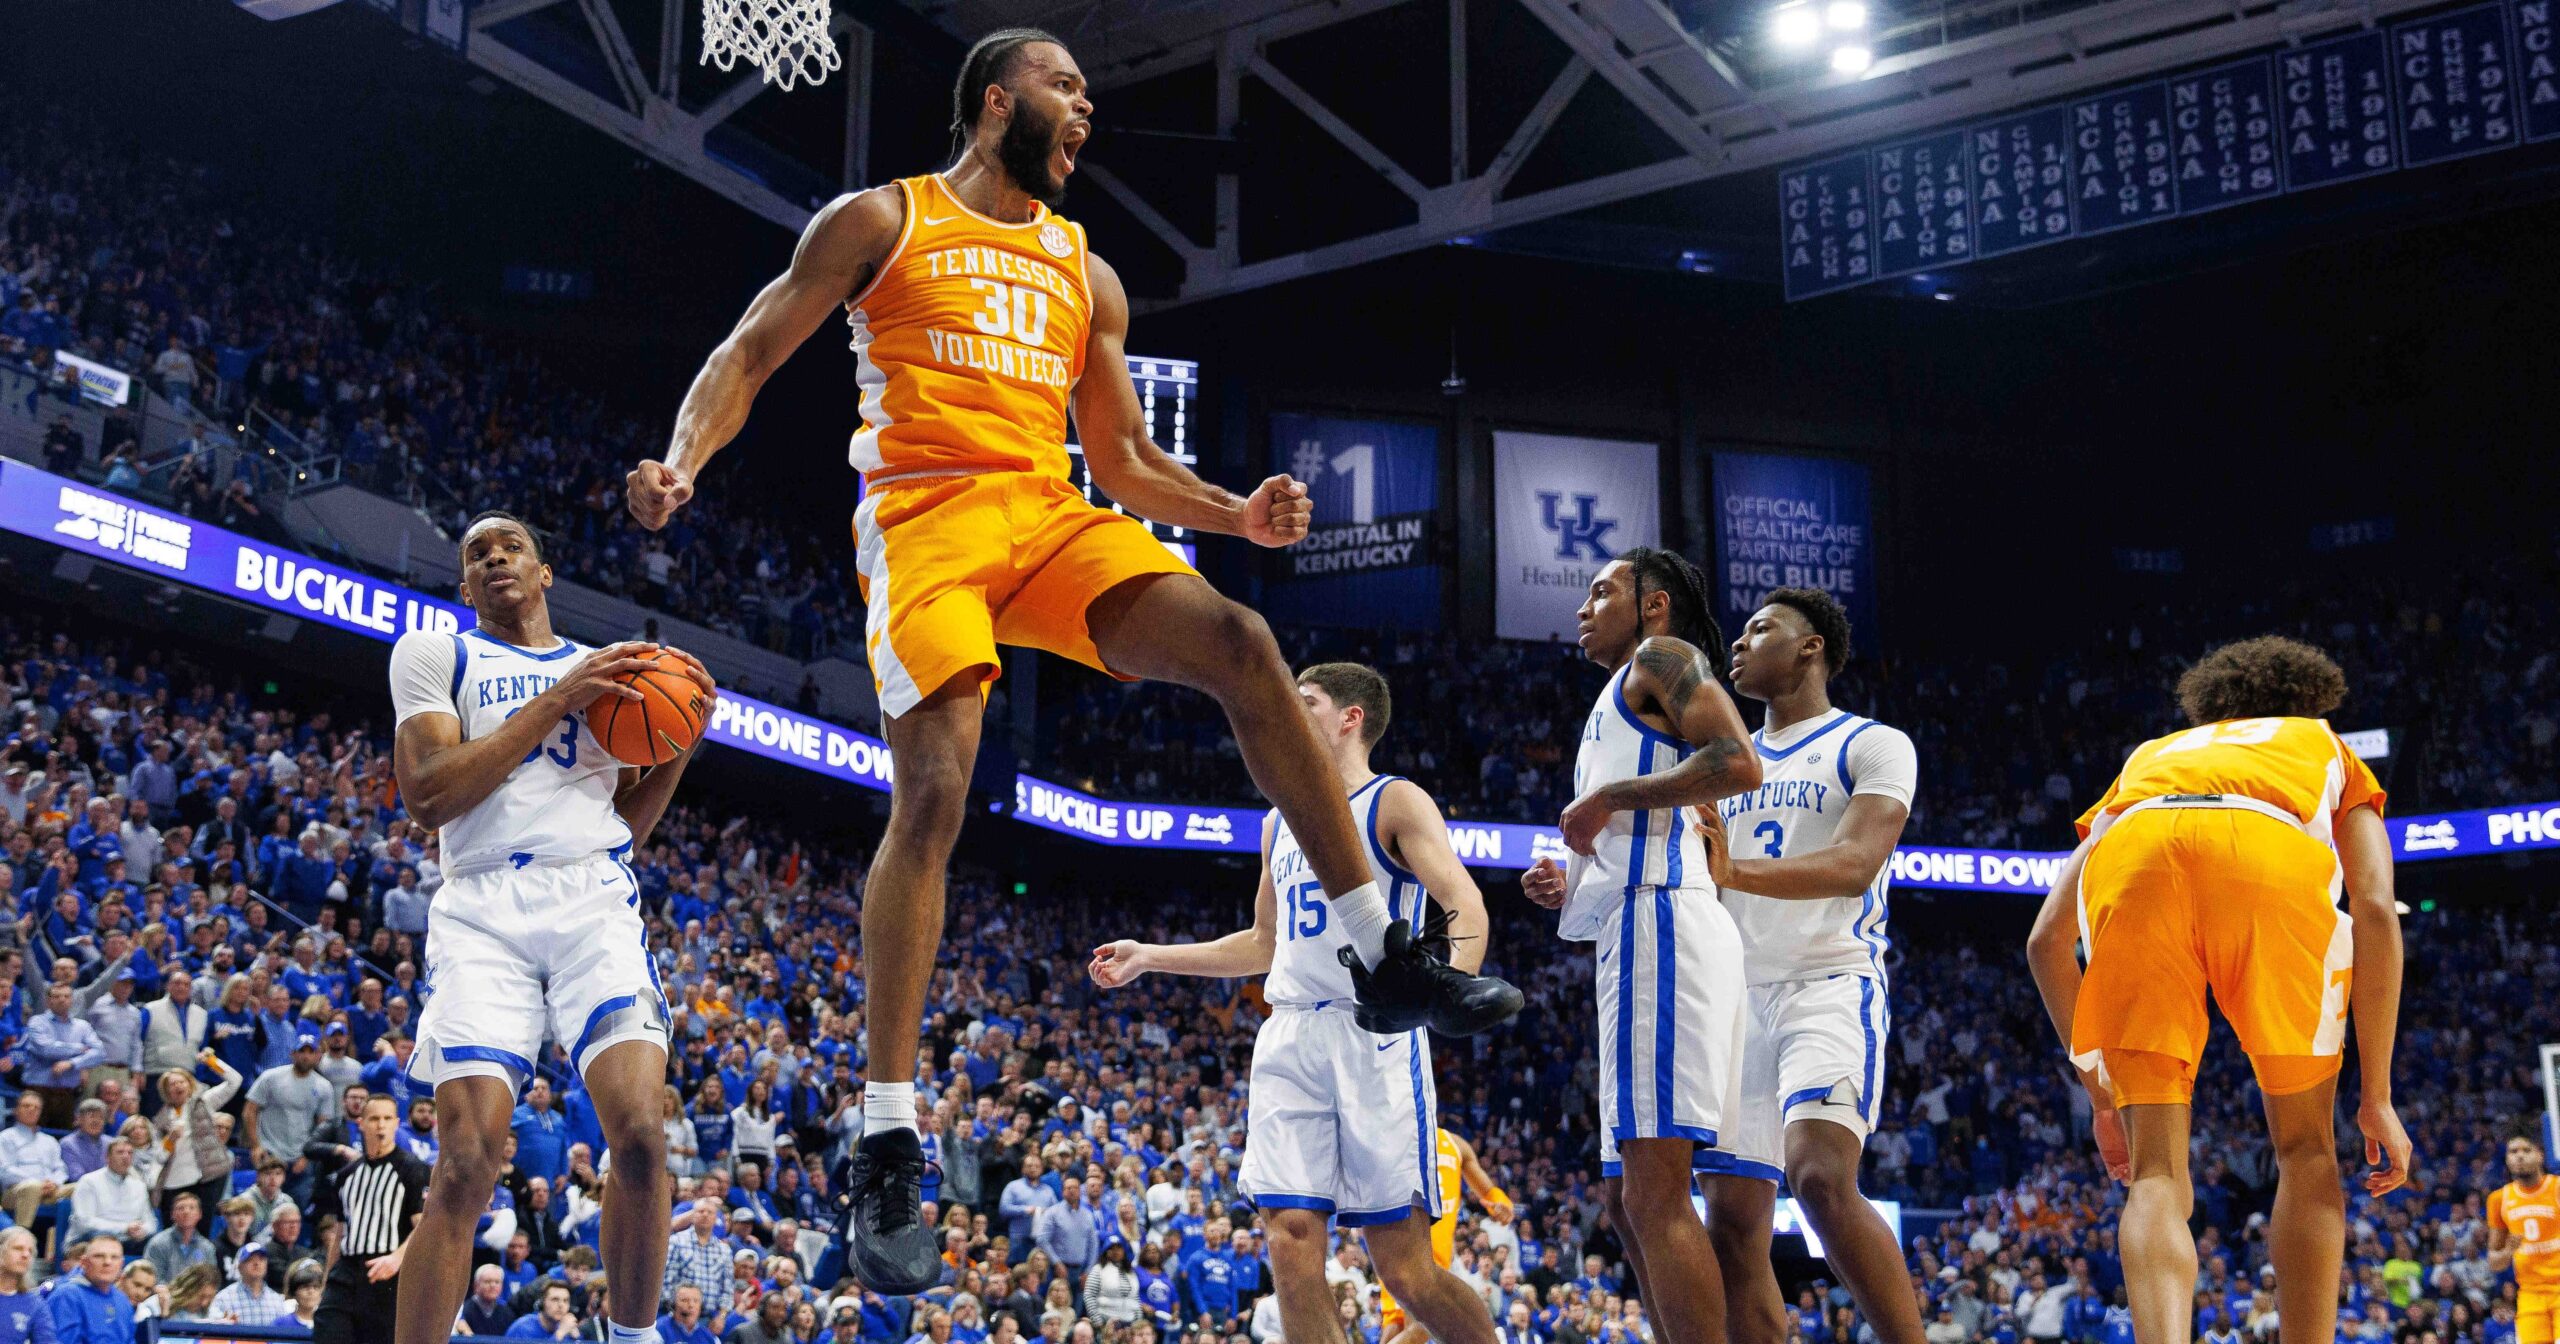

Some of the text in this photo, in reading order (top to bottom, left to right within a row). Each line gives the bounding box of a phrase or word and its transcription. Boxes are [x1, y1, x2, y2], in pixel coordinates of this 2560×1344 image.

[2402, 29, 2436, 130] NCAA
[2478, 41, 2509, 141] 1975
[2521, 2, 2558, 104] NCAA
[2175, 81, 2204, 180] NCAA
[2245, 95, 2273, 189] 1958
[2285, 54, 2315, 154] NCAA
[2360, 69, 2389, 167] 1966
[1975, 129, 2004, 225] NCAA
[2042, 144, 2067, 234] 1949
[2075, 104, 2105, 199] NCAA
[2144, 118, 2169, 212] 1951
[1787, 175, 1811, 267] NCAA
[1882, 152, 1905, 242] NCAA
[1944, 164, 1968, 255] 1948
[927, 247, 1075, 308] TENNESSEE
[970, 277, 1048, 347] 30
[926, 329, 1068, 386] VOLUNTEERS
[1396, 519, 1422, 541] IN
[1535, 489, 1618, 562] UK
[1725, 495, 1823, 521] OFFICIAL
[1727, 517, 1862, 545] HEALTHCARE
[235, 546, 459, 634] BUCKLE UP
[1295, 541, 1414, 575] KENTUCKY
[1522, 566, 1593, 589] Health
[1728, 540, 1857, 567] PARTNER OF
[1729, 560, 1855, 592] BIG BLUE
[505, 706, 579, 769] 3
[712, 696, 822, 761] PHONE
[826, 732, 894, 784] DOW
[1031, 786, 1118, 838] BUCKLE
[1126, 809, 1174, 841] UP
[1753, 820, 1784, 859] 3
[1890, 851, 2068, 886] HONE DOW
[1286, 880, 1327, 942] 15
